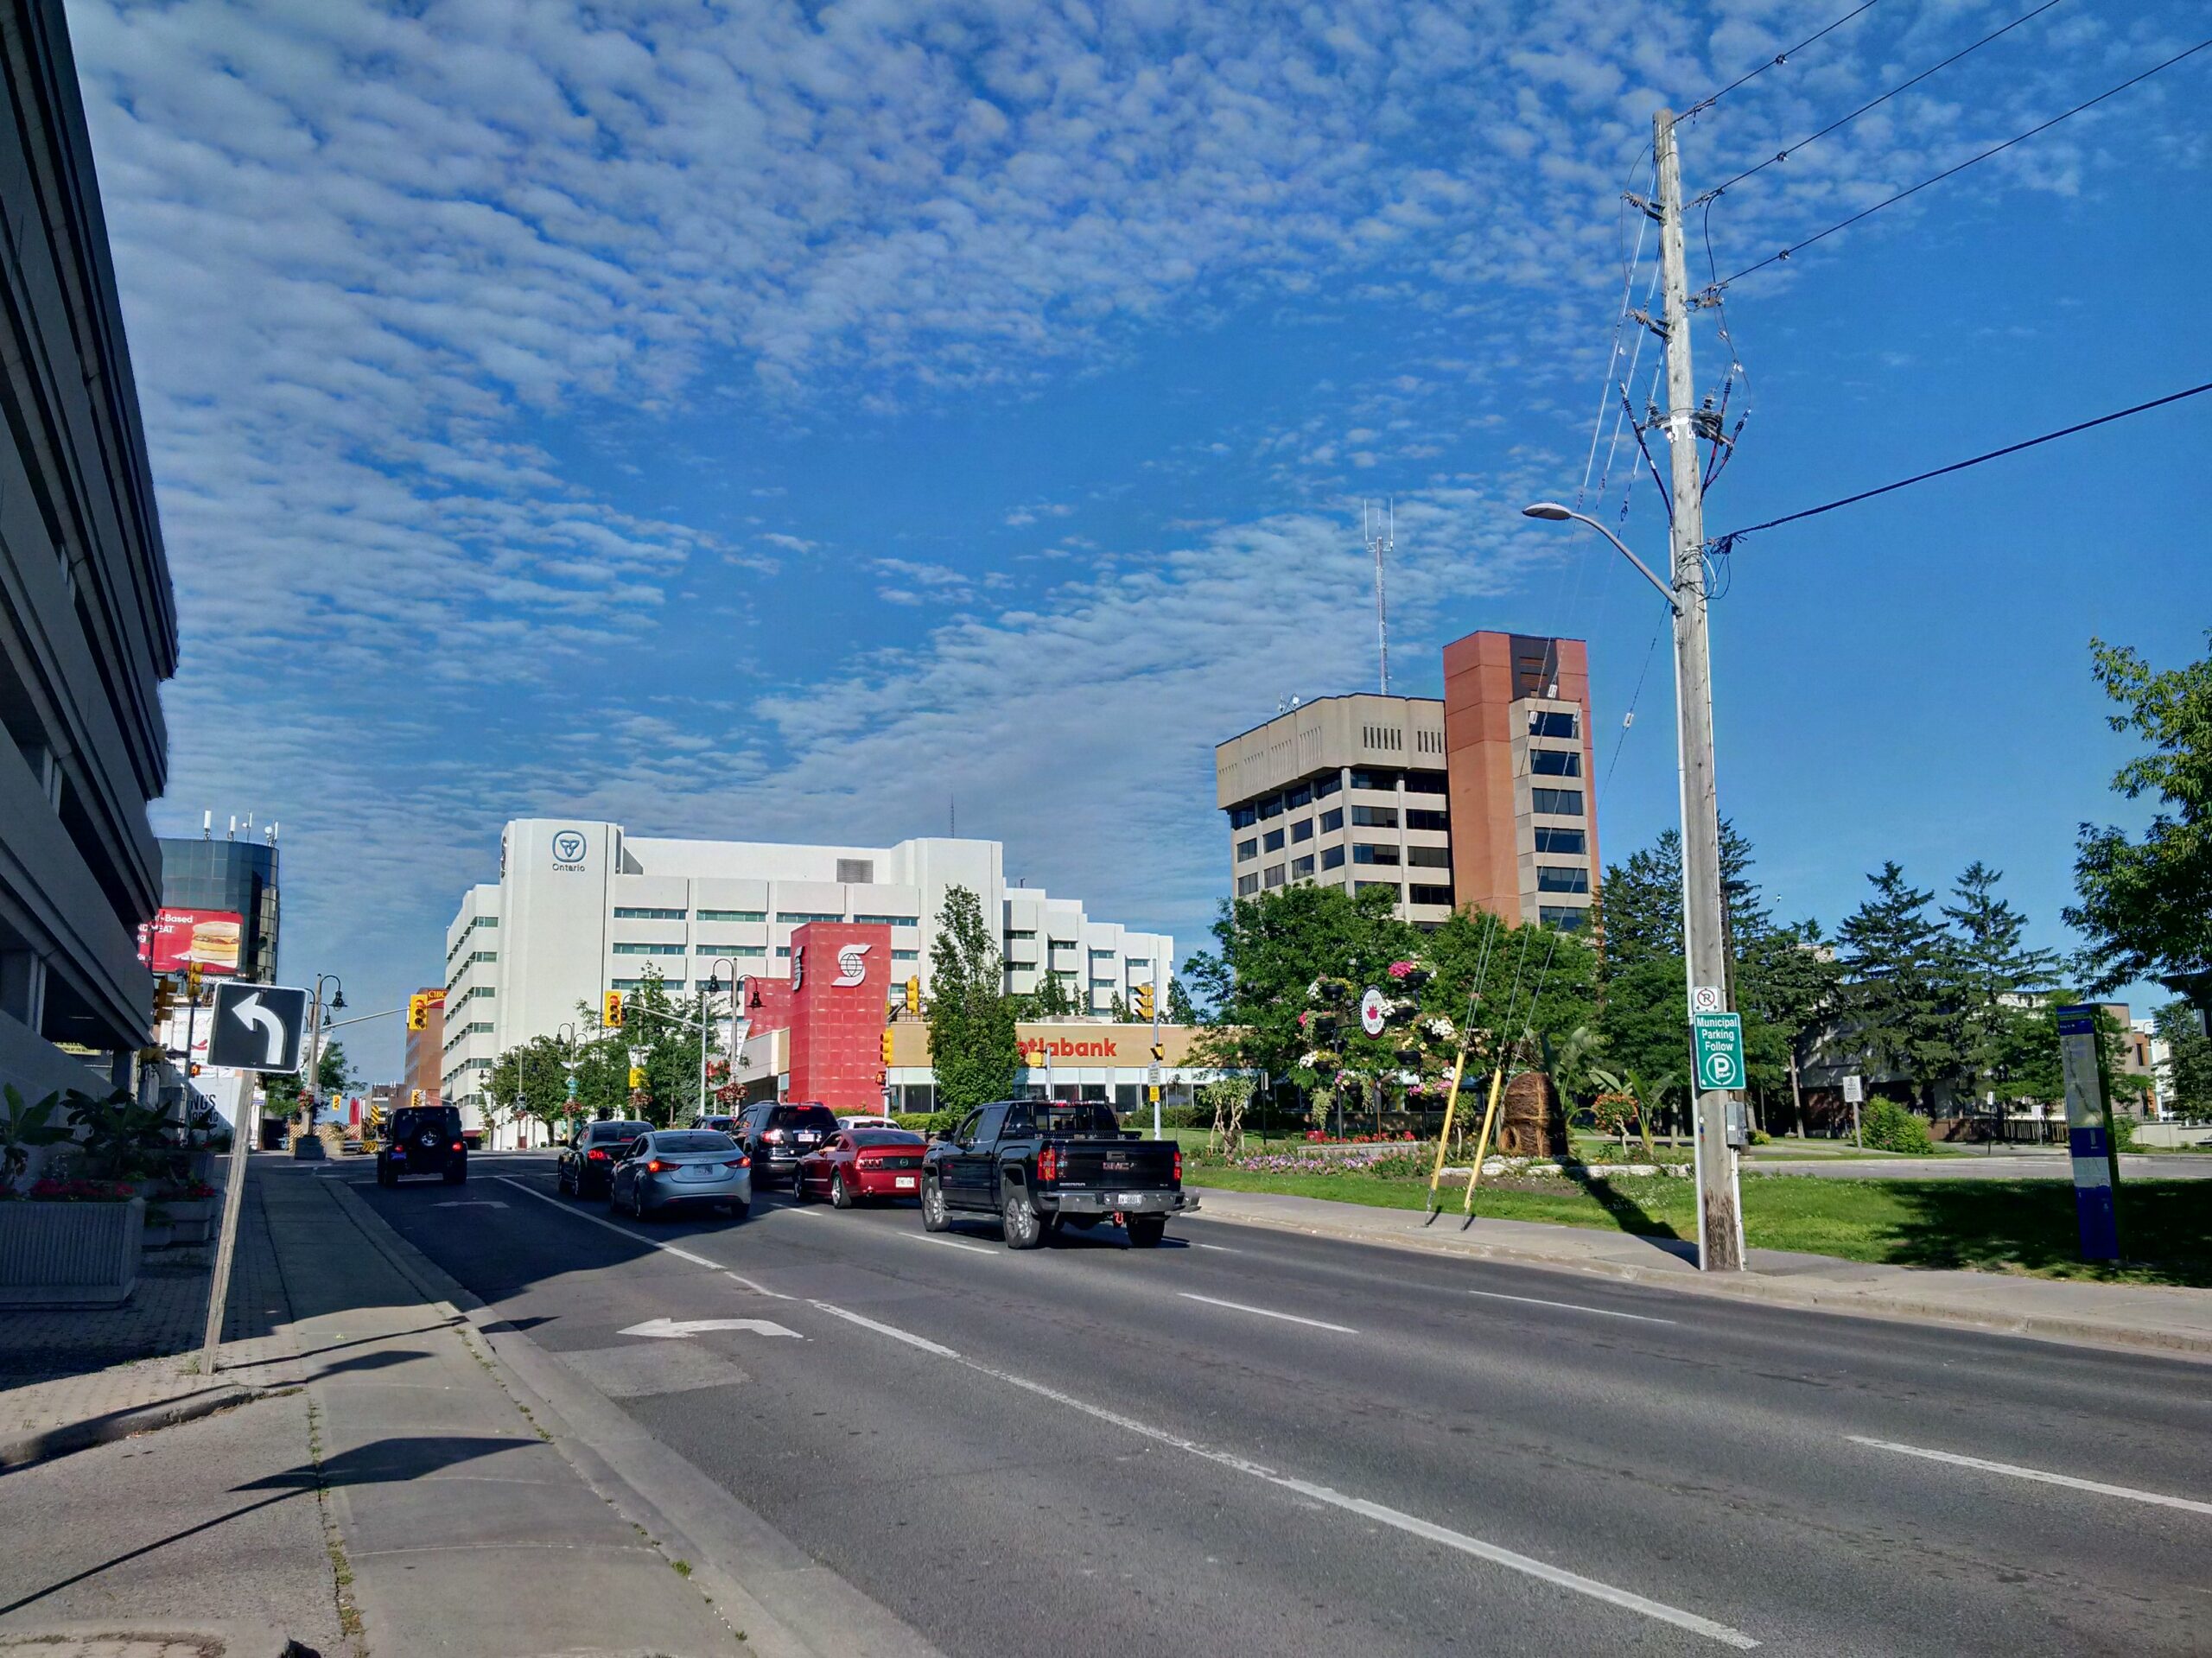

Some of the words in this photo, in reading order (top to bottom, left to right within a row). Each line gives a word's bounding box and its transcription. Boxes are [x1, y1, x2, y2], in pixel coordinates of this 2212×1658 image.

[552, 863, 586, 872] Ontario
[1696, 1017, 1738, 1030] Municipal
[1701, 1029, 1734, 1042] Parking
[1705, 1041, 1733, 1051] Follow
